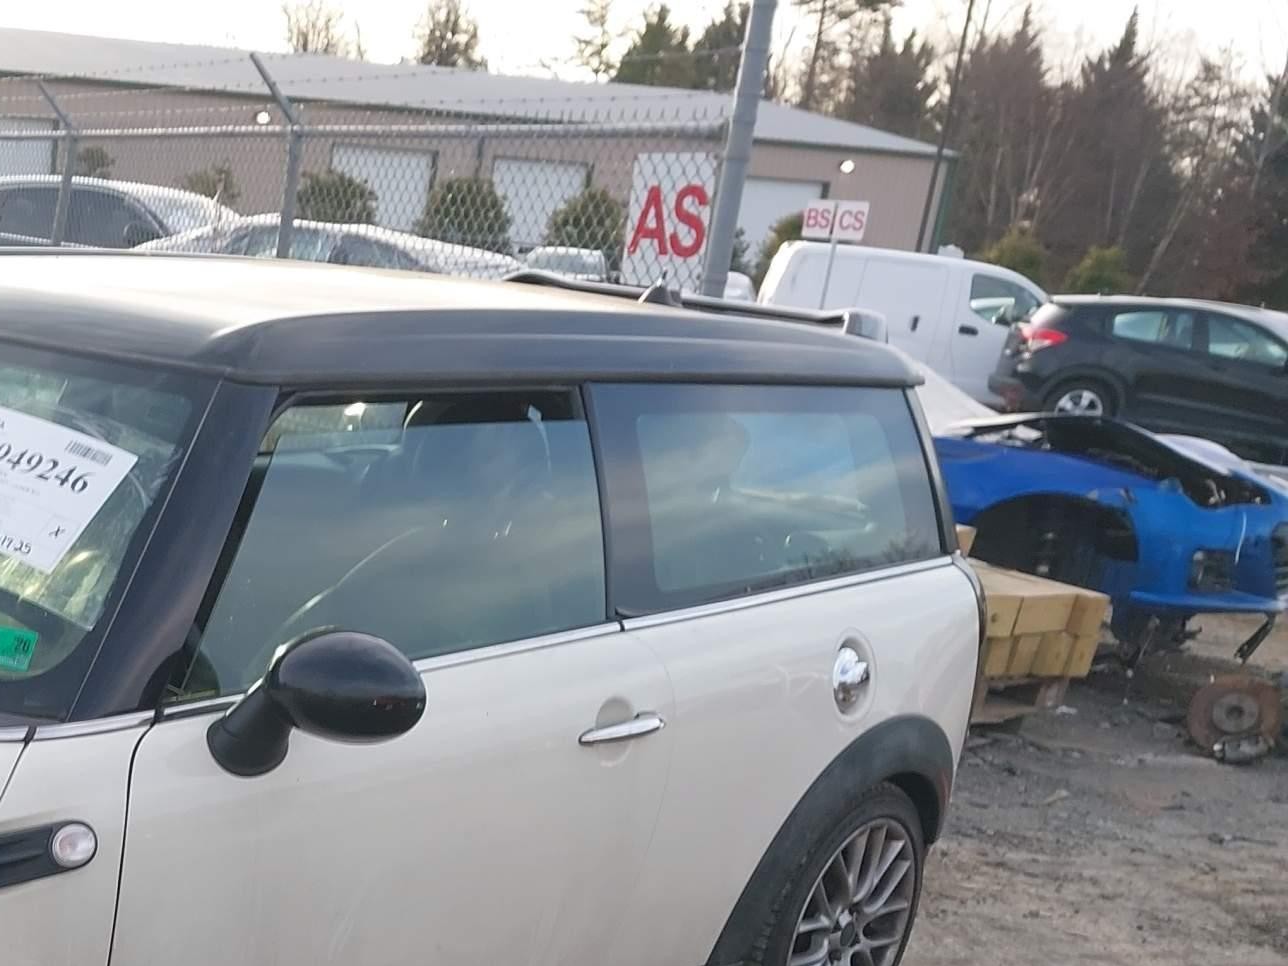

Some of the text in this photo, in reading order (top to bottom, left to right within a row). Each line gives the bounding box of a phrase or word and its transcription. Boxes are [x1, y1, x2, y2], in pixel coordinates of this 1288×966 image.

[628, 185, 708, 257] AS
[806, 208, 831, 229] BS
[839, 209, 866, 231] CS
